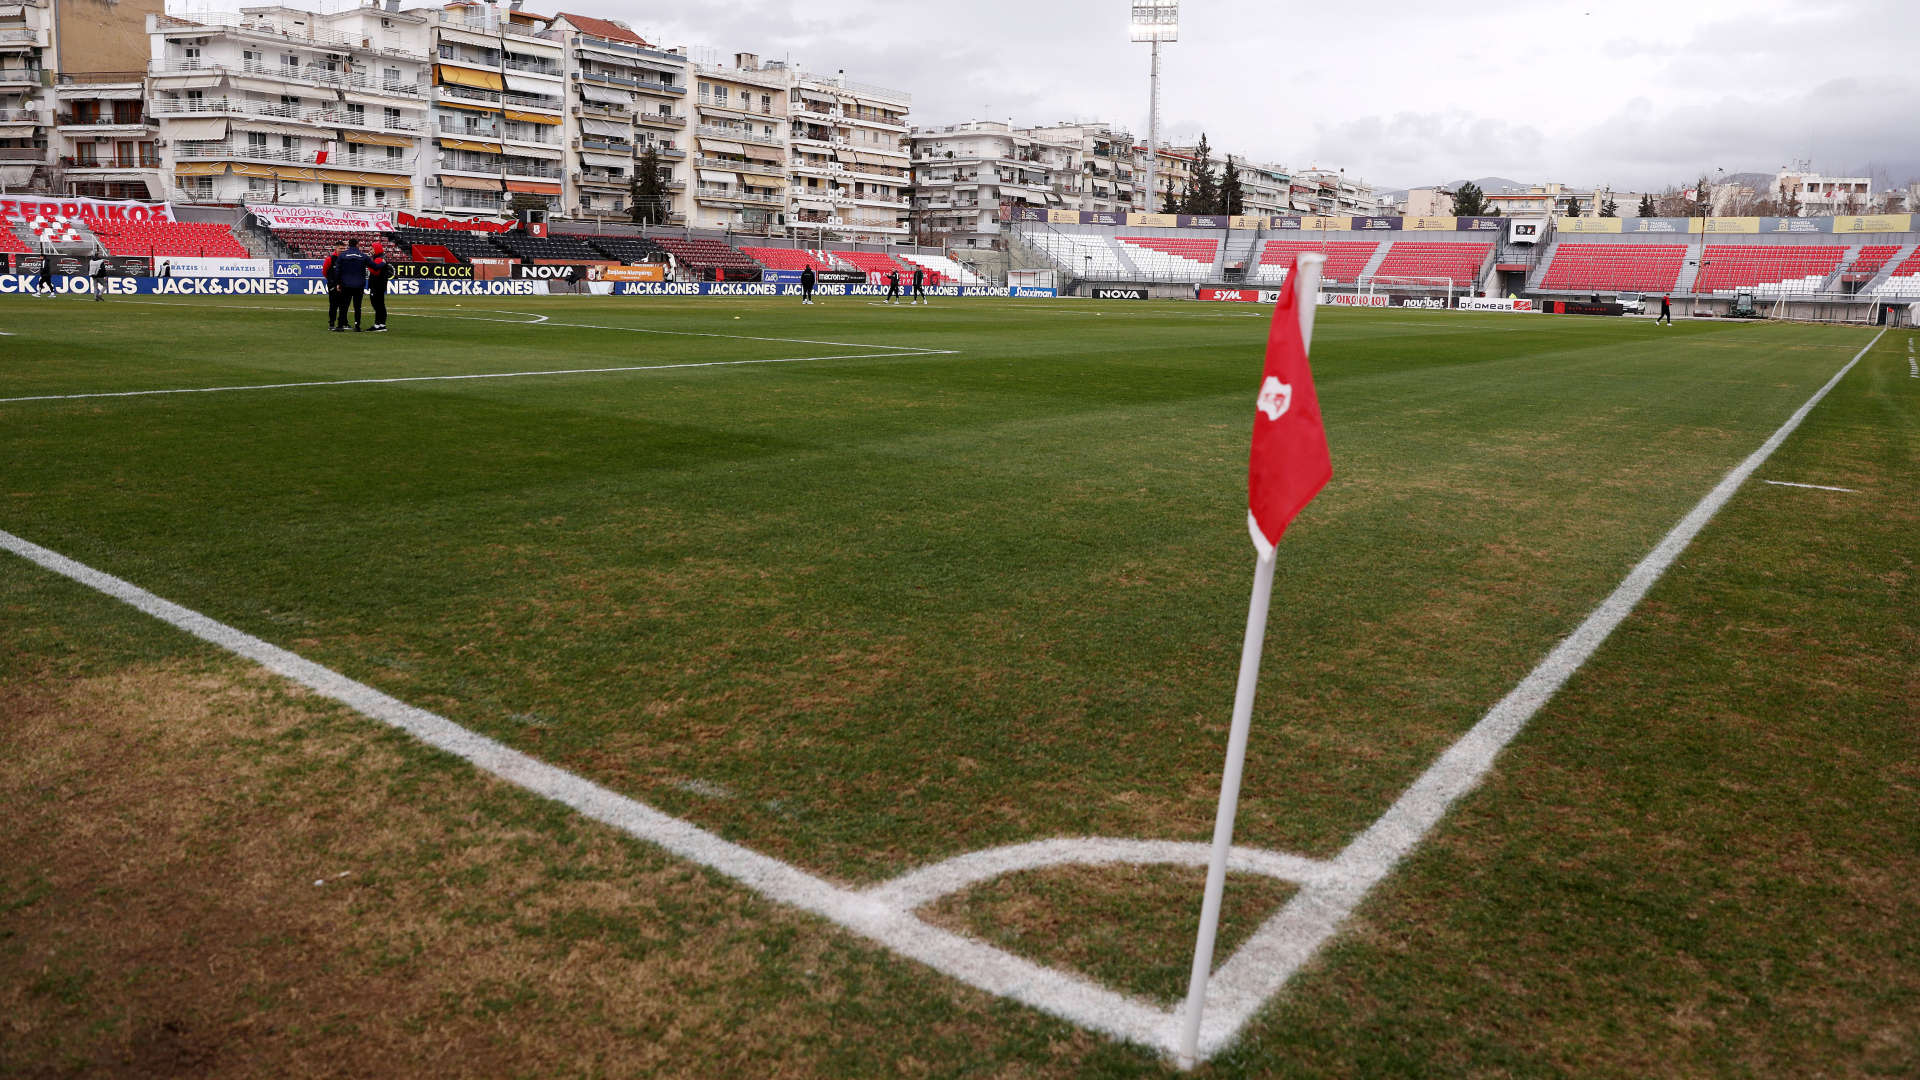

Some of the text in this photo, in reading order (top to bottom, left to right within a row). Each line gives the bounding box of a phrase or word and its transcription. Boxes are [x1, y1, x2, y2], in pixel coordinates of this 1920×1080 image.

[397, 265, 472, 277] FIT O CLOCK
[152, 278, 289, 295] JACK&JONES
[430, 281, 533, 295] JACK&JONES
[622, 283, 700, 295] JACK&JONES
[707, 284, 777, 295] JACK&JONES
[1099, 289, 1140, 299] NOVA
[1213, 290, 1242, 300] SYM
